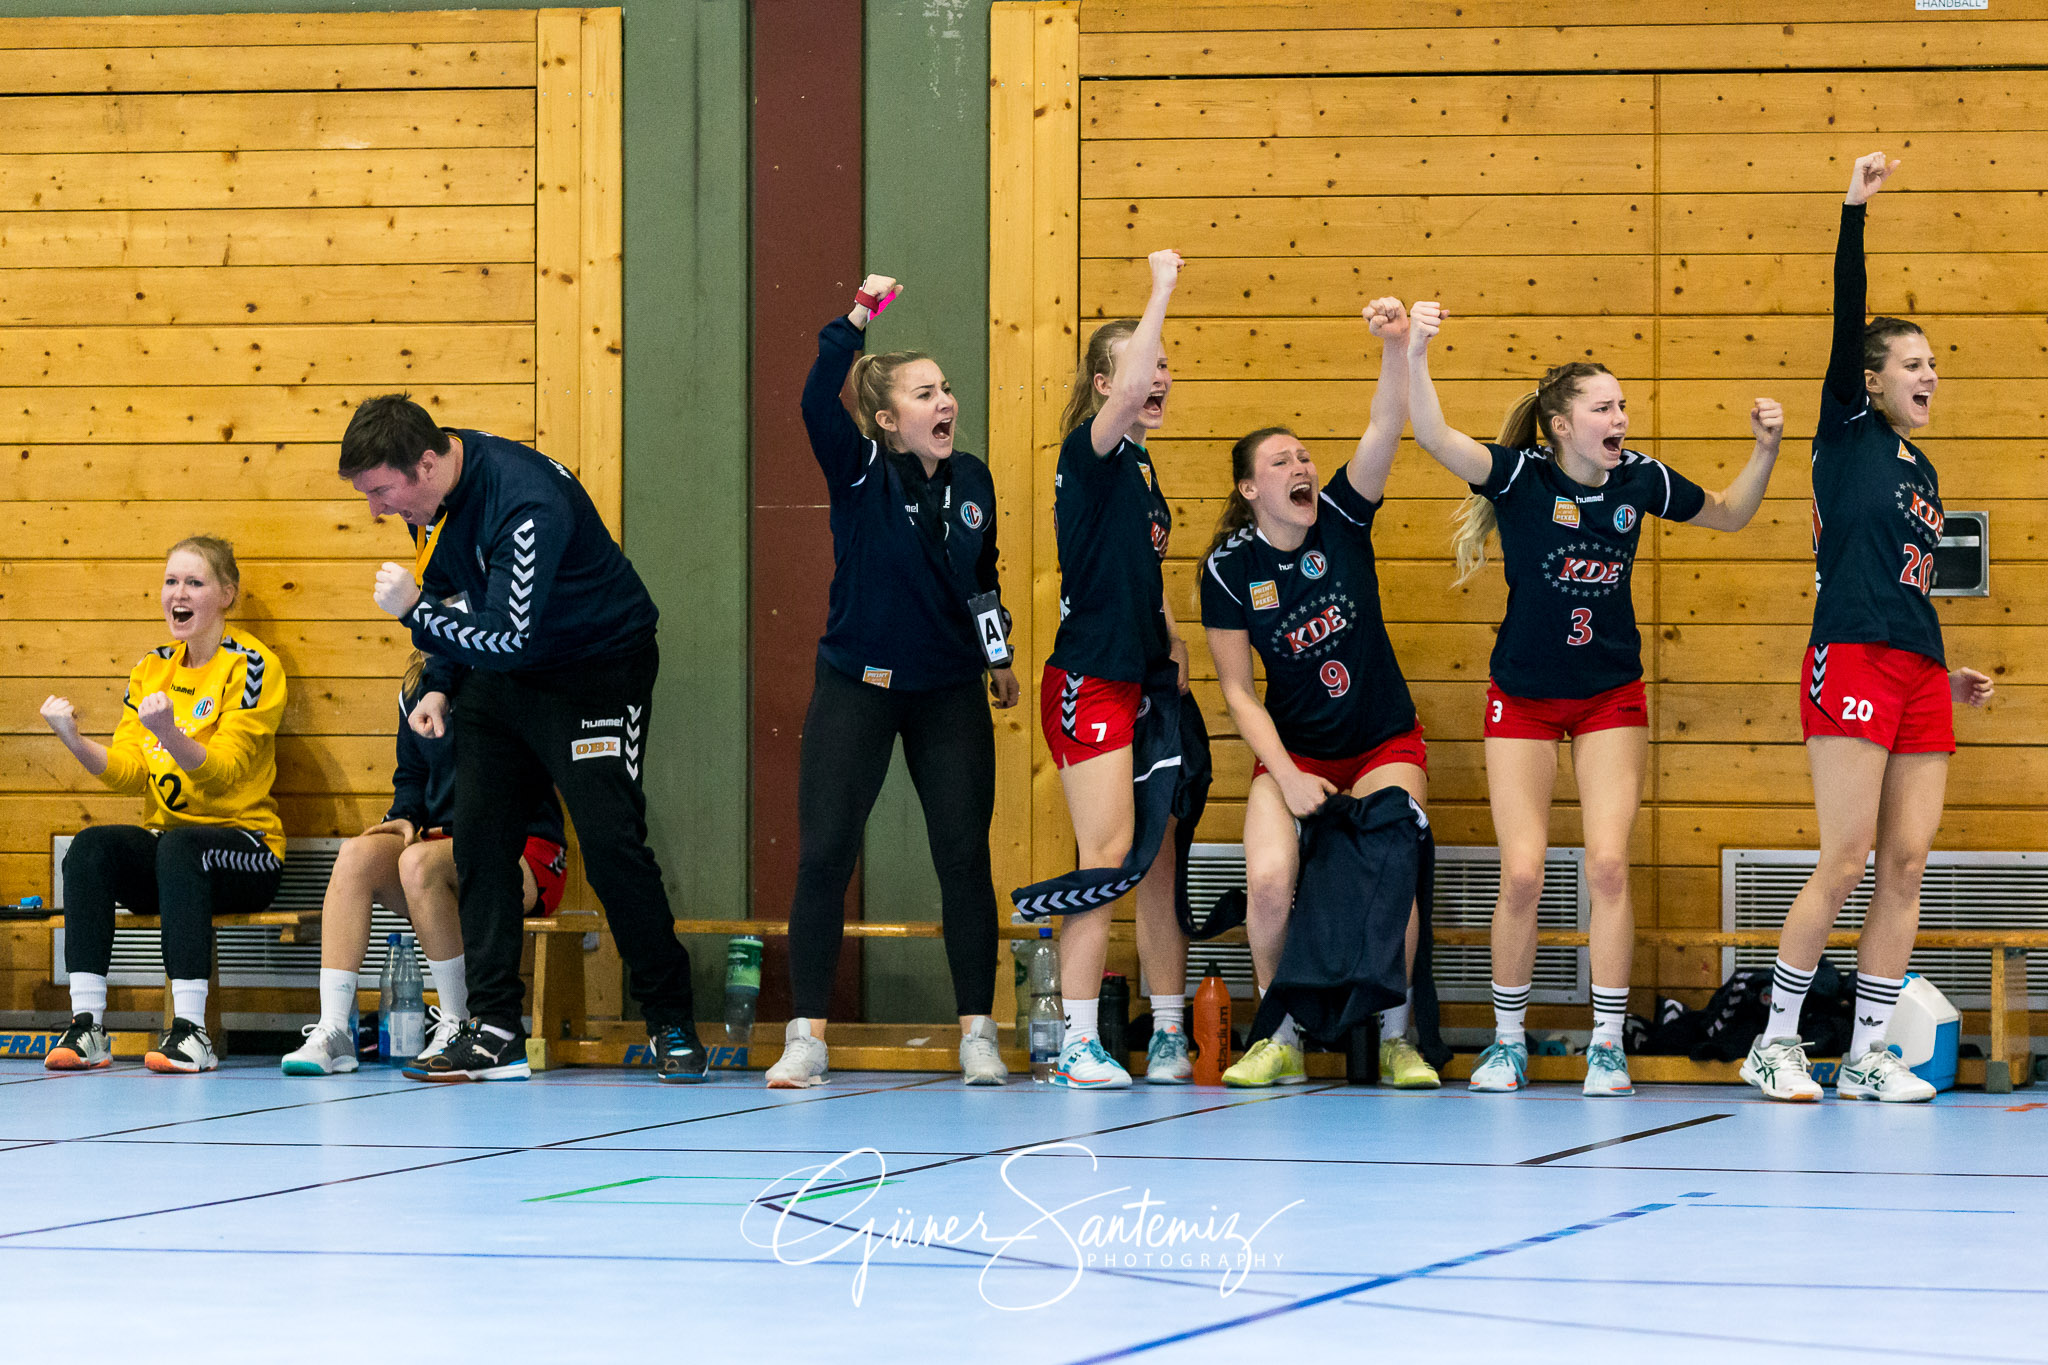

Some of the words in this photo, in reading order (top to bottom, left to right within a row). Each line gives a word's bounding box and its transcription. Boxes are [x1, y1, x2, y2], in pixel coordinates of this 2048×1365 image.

[1576, 493, 1604, 504] hummel
[1558, 557, 1624, 585] KDE
[1900, 543, 1934, 595] 20
[1254, 584, 1273, 595] PRINT
[1255, 596, 1273, 607] PIXEL
[985, 617, 1001, 646] A
[1284, 605, 1347, 654] KDE
[1567, 607, 1593, 646] 3
[170, 683, 196, 696] hummel
[1319, 659, 1350, 698] 9
[1491, 700, 1503, 723] 3
[1842, 696, 1874, 722] 20
[581, 716, 624, 729] hummel
[1091, 722, 1107, 743] 7
[575, 741, 617, 755] OBI
[1217, 1006, 1228, 1072] stadium
